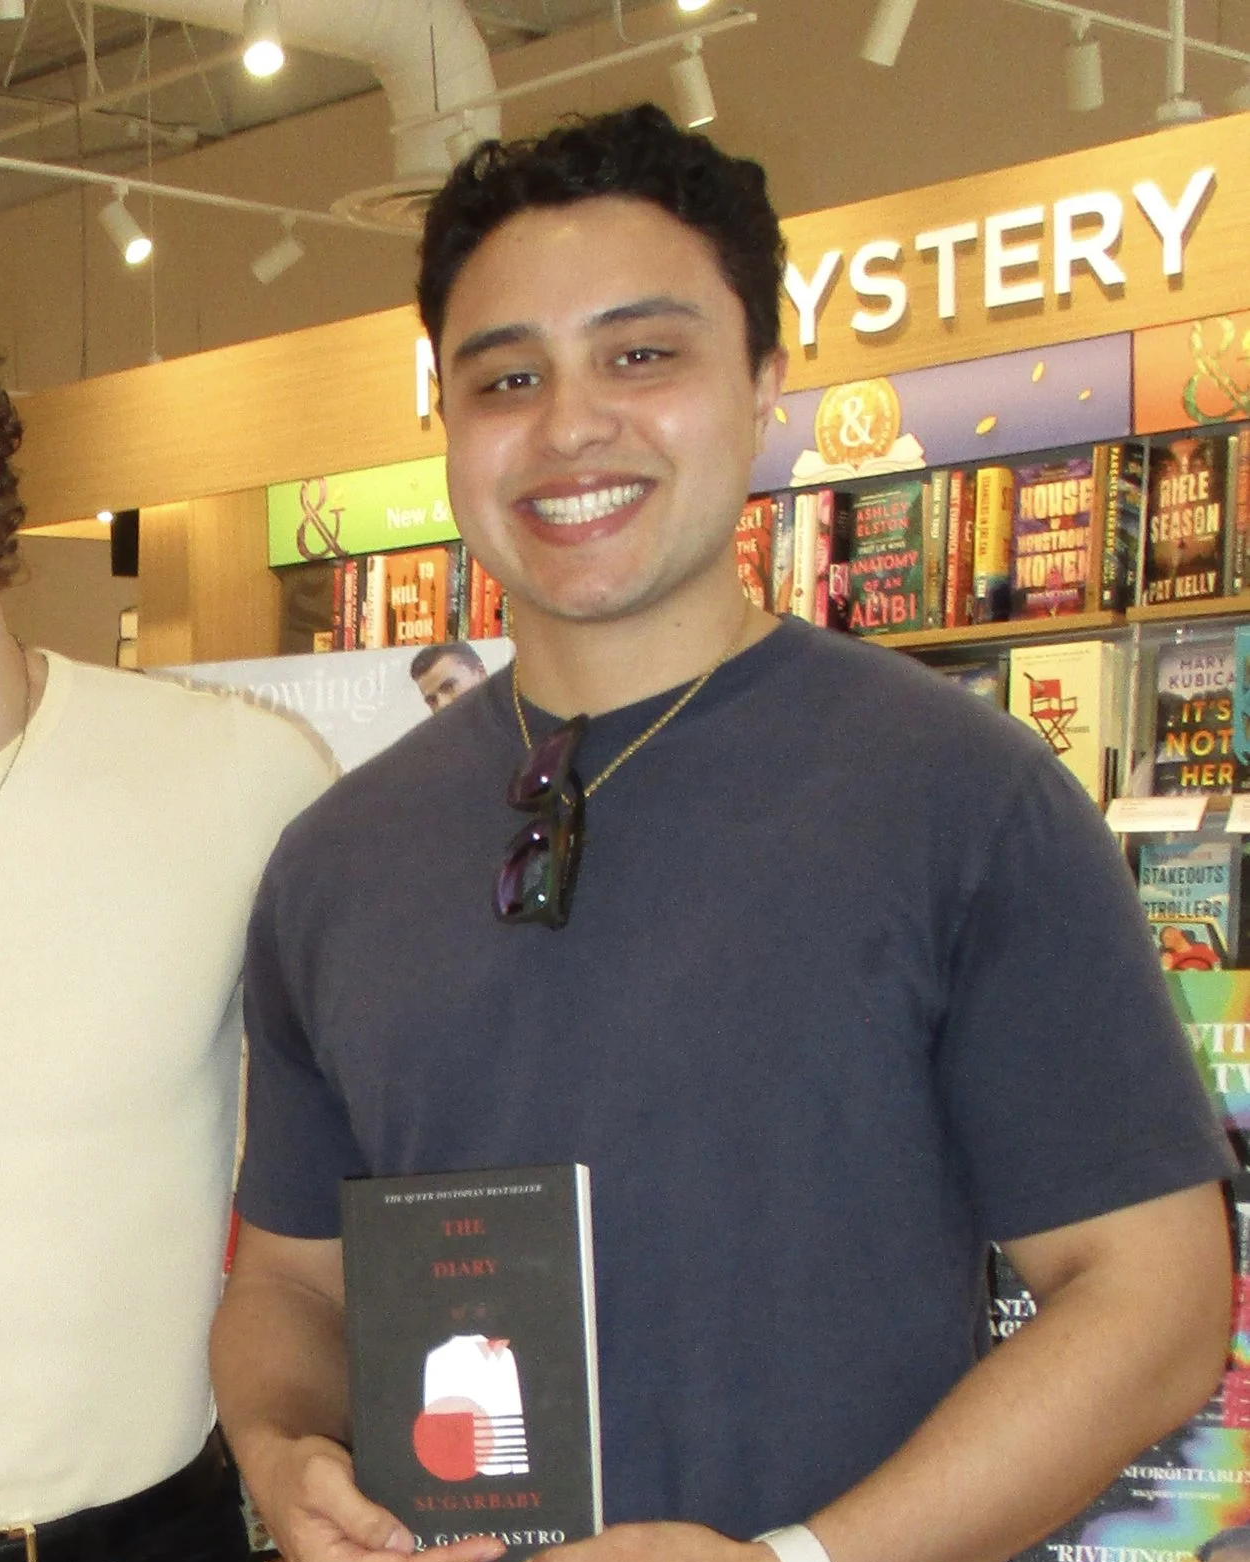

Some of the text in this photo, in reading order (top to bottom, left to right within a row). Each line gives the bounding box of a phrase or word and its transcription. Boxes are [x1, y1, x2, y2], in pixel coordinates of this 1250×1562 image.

[783, 166, 1216, 346] YSTERY
[1019, 476, 1094, 521] HOUSE
[386, 507, 426, 530] New
[1151, 503, 1221, 544] SEASON
[850, 550, 918, 575] ANATOMY
[391, 583, 418, 608] KILL
[849, 592, 917, 629] ALIBI
[398, 616, 433, 640] COOK
[1179, 654, 1225, 671] MARY
[1169, 671, 1235, 690] KUBICA
[1181, 699, 1231, 724] IT'S
[1166, 728, 1233, 757] NOT
[1181, 763, 1234, 788] HER
[1142, 865, 1224, 885] STAKEOUTS
[433, 1258, 497, 1279] DIARY
[414, 1491, 542, 1511] SUGARBABY
[435, 1529, 565, 1547] GASTRO
